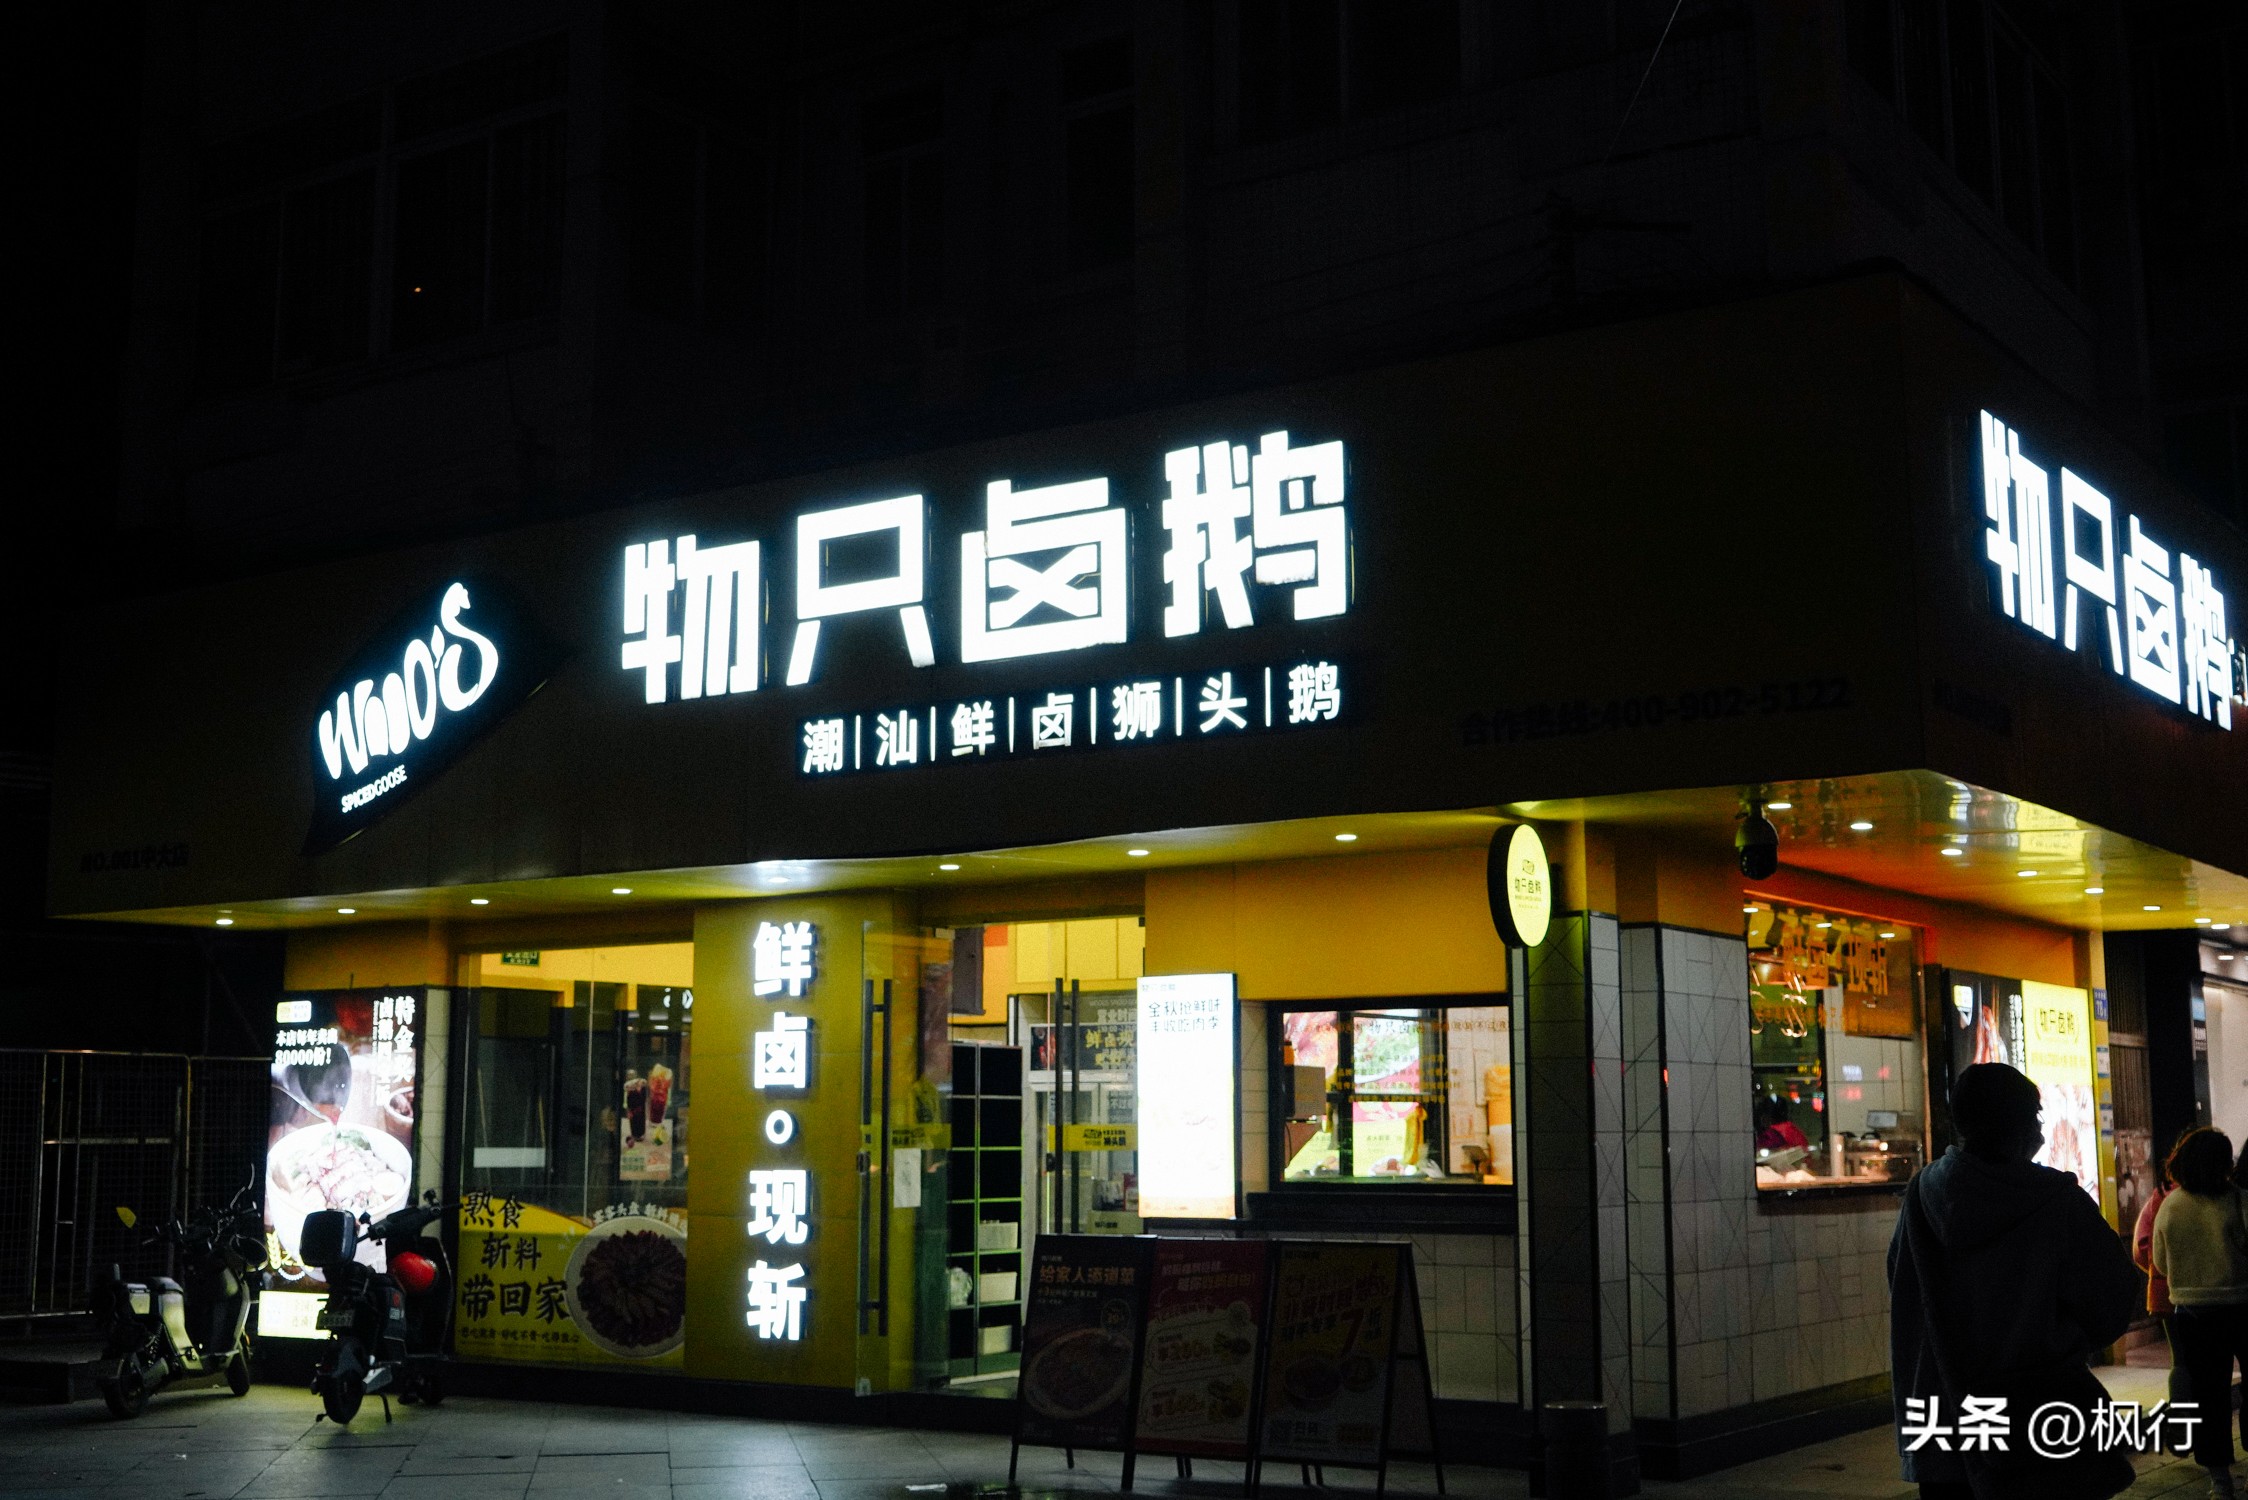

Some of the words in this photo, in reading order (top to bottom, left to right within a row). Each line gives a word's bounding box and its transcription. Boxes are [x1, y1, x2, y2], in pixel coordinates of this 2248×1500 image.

[622, 430, 1347, 704] 物只卤鹅
[1981, 409, 2231, 731] 物只卤鹅
[463, 1190, 524, 1229] 熟食
[480, 1233, 542, 1270] 斩料
